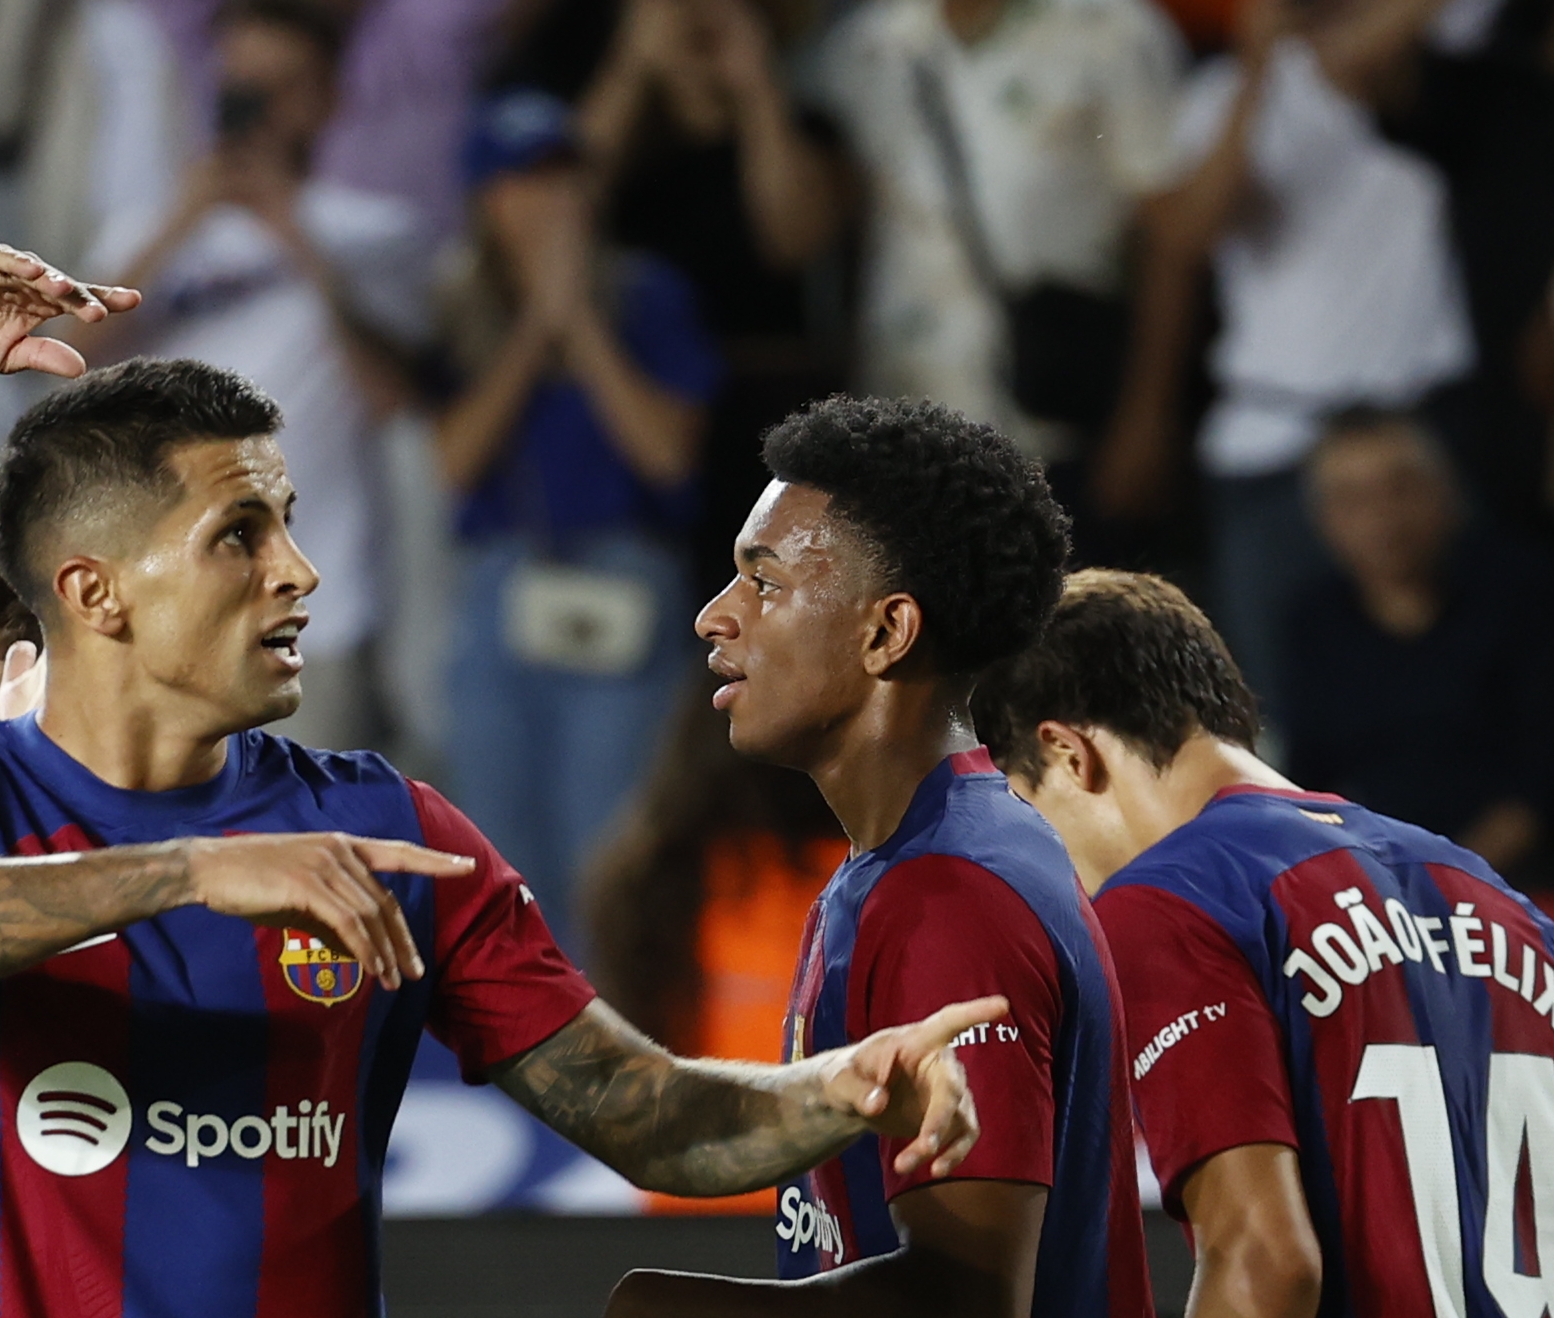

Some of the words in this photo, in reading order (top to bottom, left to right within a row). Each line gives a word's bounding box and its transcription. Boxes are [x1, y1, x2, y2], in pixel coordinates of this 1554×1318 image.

[1283, 886, 1423, 1018] JOÃO
[996, 1023, 1019, 1042] tv
[1203, 1002, 1225, 1021] tv
[145, 1100, 346, 1168] Spotify
